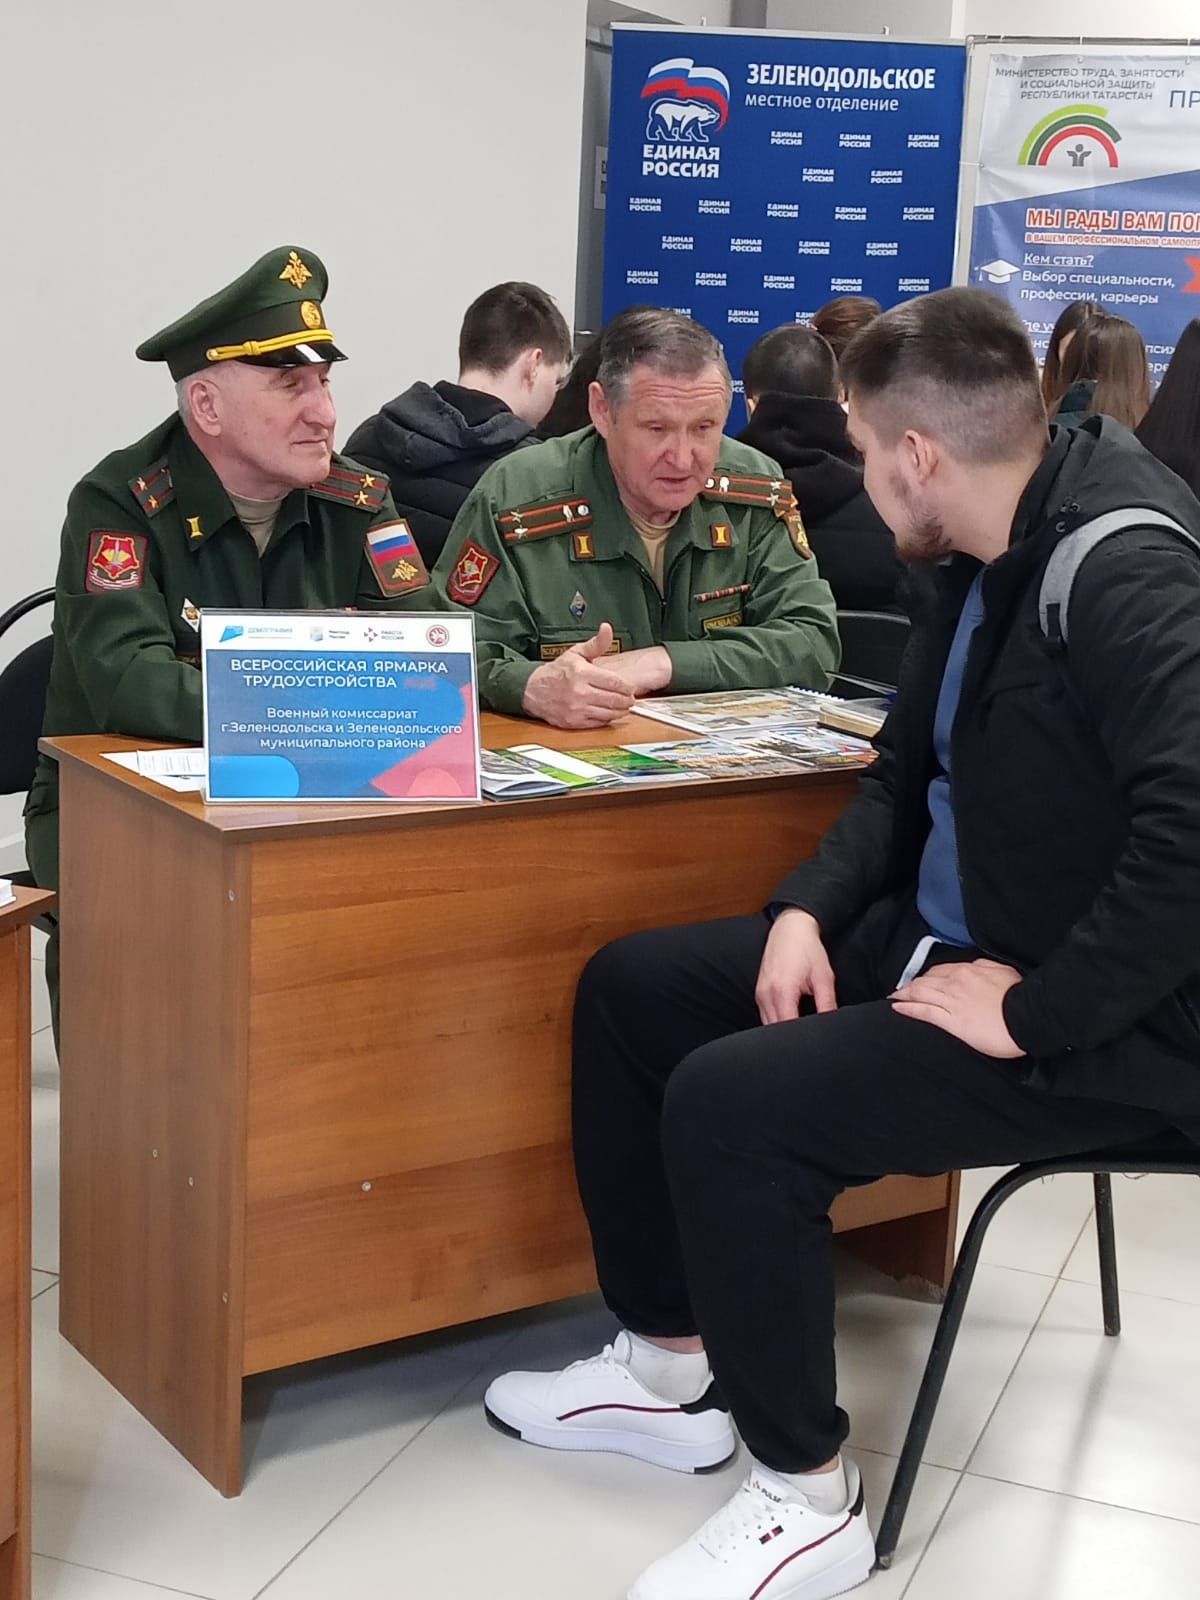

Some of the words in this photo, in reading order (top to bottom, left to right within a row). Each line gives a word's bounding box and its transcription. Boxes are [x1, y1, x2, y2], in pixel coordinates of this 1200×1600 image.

[746, 63, 936, 91] ЗЕЛЕНОДОЛЬСКОЕ
[995, 67, 1079, 78] МИНИСТЕРСТВО
[1120, 68, 1184, 78] ЗАНЯТОСТИ
[1019, 80, 1028, 89] И
[1029, 78, 1105, 90] СОЦИАЛЬНОЙ
[1107, 80, 1156, 90] ЗАЩИТЫ
[745, 93, 812, 110] местное
[816, 96, 899, 113] отделение
[1020, 90, 1090, 100] РЕСПУБЛИКИ
[1092, 91, 1153, 100] ТАТАРСТАН
[643, 144, 720, 161] ЕДИНАЯ
[642, 161, 720, 178] РОССИЯ
[1026, 208, 1060, 228] МЫ
[1065, 209, 1119, 231] РАДЫ
[1121, 211, 1165, 231] ВАМ
[1025, 232, 1032, 243] В
[1033, 232, 1065, 244] ВАШЕМ
[1066, 234, 1159, 247] ПРОФЕССИОНАЛЬНОМ
[1024, 253, 1050, 265] Кем
[1053, 254, 1094, 266] стать?
[1022, 271, 1070, 284] Выбор
[1069, 273, 1175, 288] специальности,
[1021, 288, 1098, 302] профессии,
[1101, 292, 1158, 304] карьеры
[231, 657, 367, 672] ВСЕРОССИЙСКАЯ
[374, 660, 448, 673] ЯРМАРКА
[243, 673, 397, 689] ТРУДОУСТРОЙСТВА
[267, 706, 329, 719] Военный
[332, 709, 418, 721] комиссариат
[221, 722, 333, 735] г.Зеленодольска
[336, 724, 344, 733] и
[347, 723, 462, 736] Зеленодольского
[260, 737, 375, 750] муниципального
[378, 739, 426, 750] района
